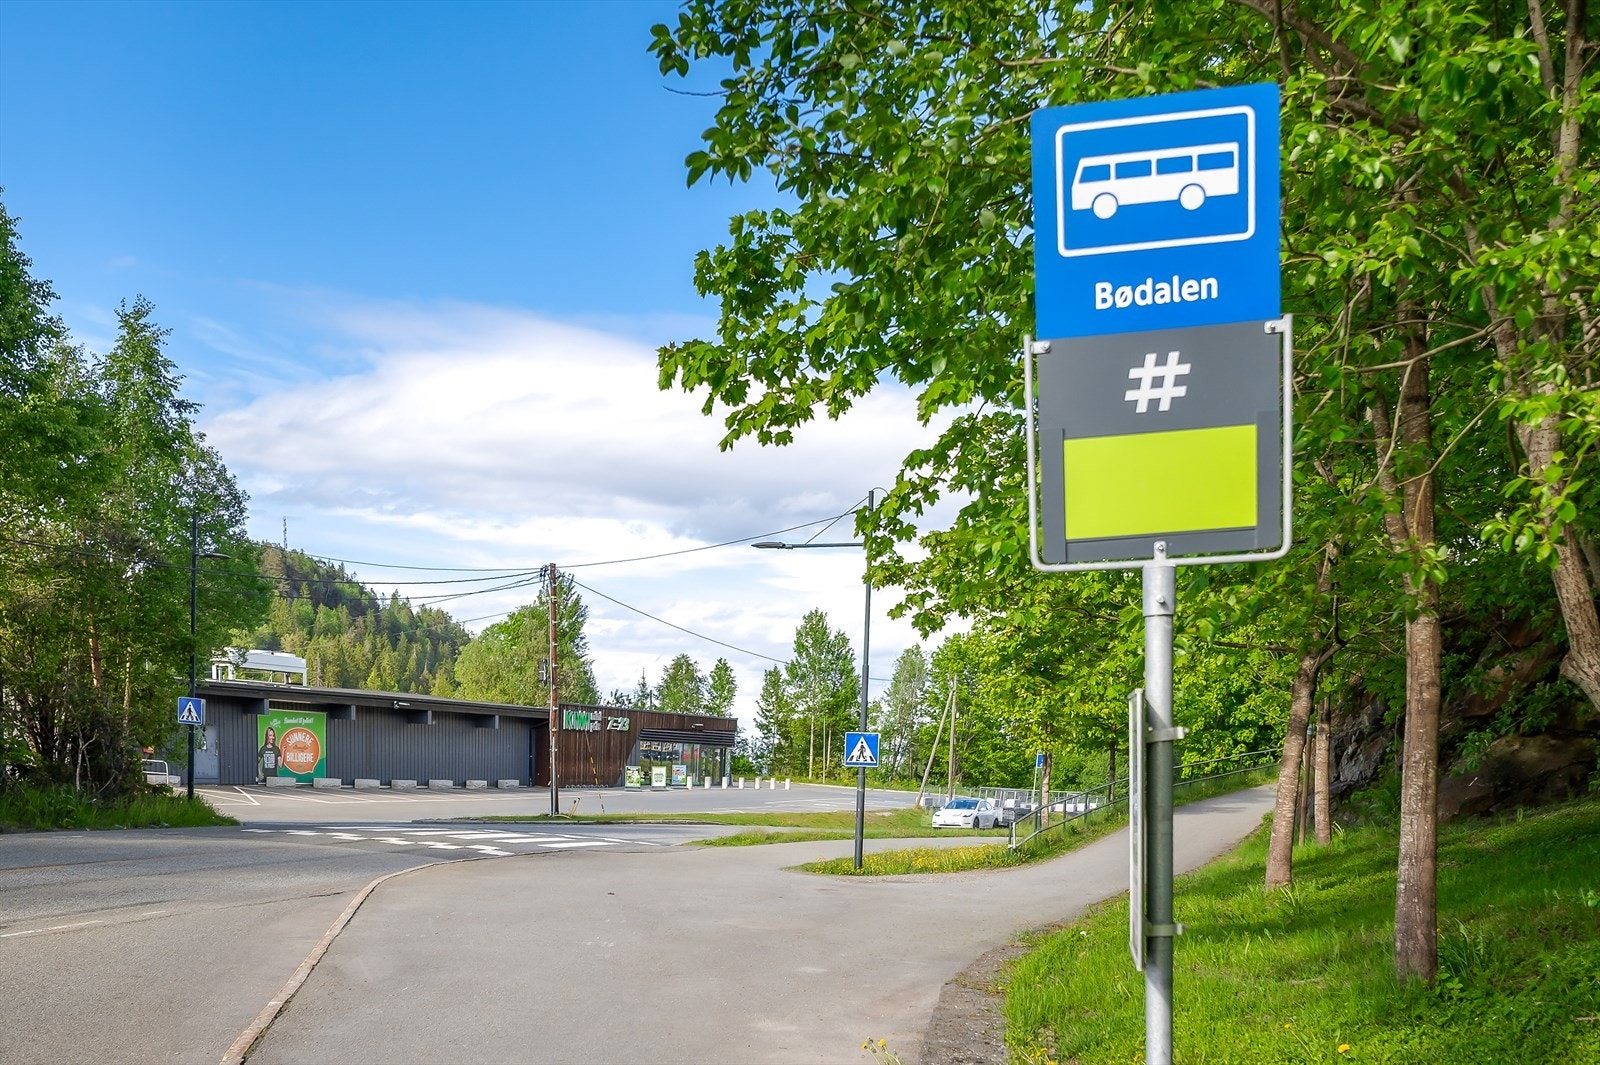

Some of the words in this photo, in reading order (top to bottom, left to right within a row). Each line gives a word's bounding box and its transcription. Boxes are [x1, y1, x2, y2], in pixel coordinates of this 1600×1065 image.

[1095, 275, 1218, 310] Bødalen
[563, 709, 590, 731] KIWI
[286, 732, 314, 746] SUNNERE
[286, 752, 314, 763] BILLIGERE
